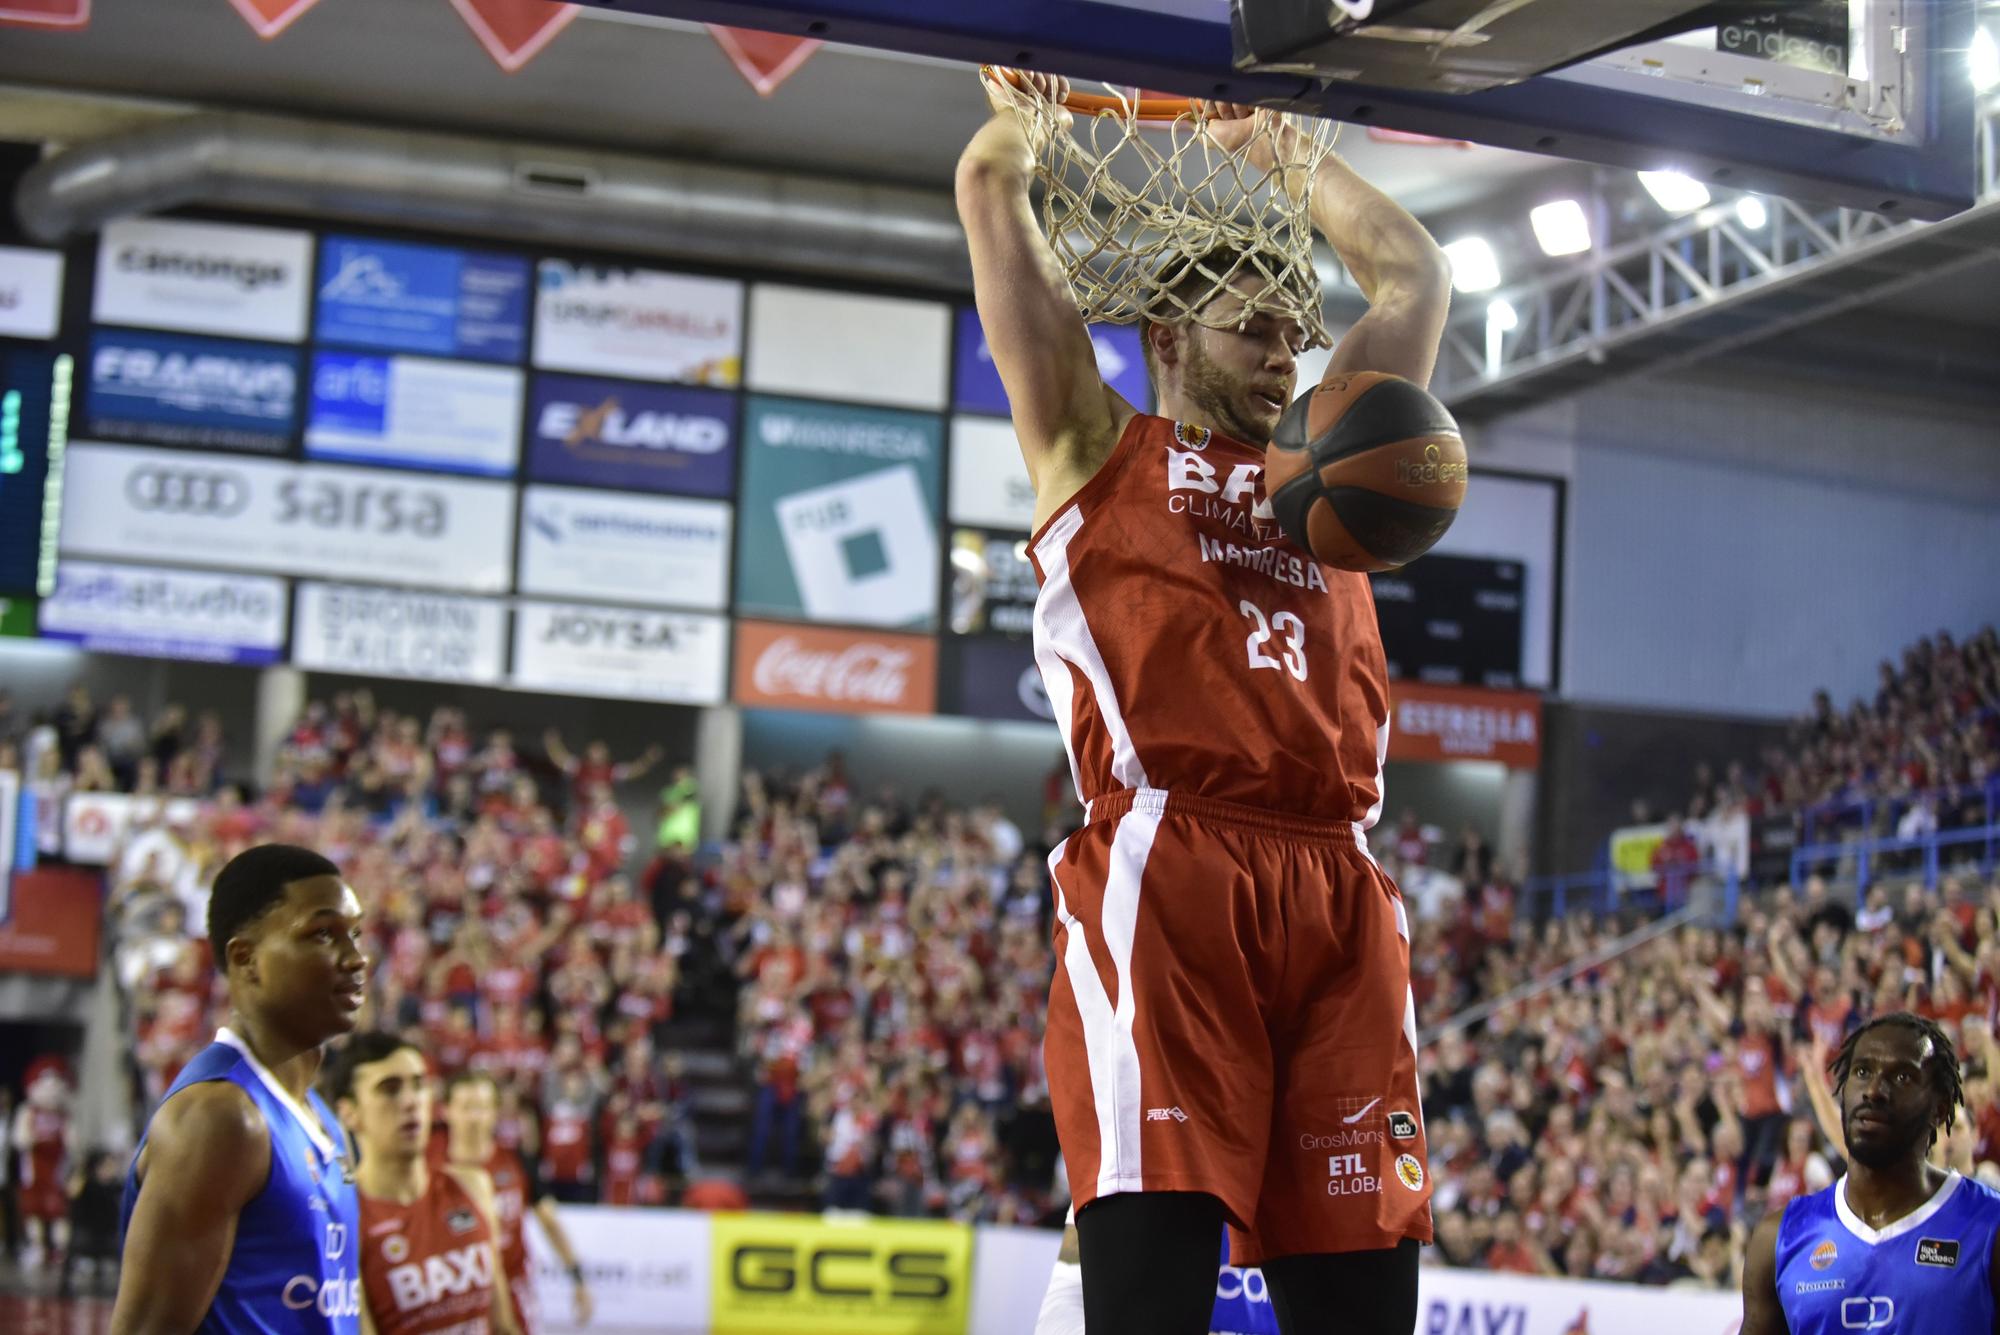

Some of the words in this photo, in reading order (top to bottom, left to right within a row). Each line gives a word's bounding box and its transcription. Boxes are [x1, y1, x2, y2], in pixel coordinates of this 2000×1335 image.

[1722, 25, 1843, 69] endesa
[276, 477, 447, 539] sarsa
[1199, 532, 1328, 593] MANRESA
[1240, 600, 1308, 681] 23
[753, 635, 912, 704] Coca-Cola
[1394, 1122, 1412, 1135] acb
[1327, 1176, 1384, 1196] GLOBA
[1328, 1153, 1367, 1177] ETL
[731, 1245, 952, 1300] GCS
